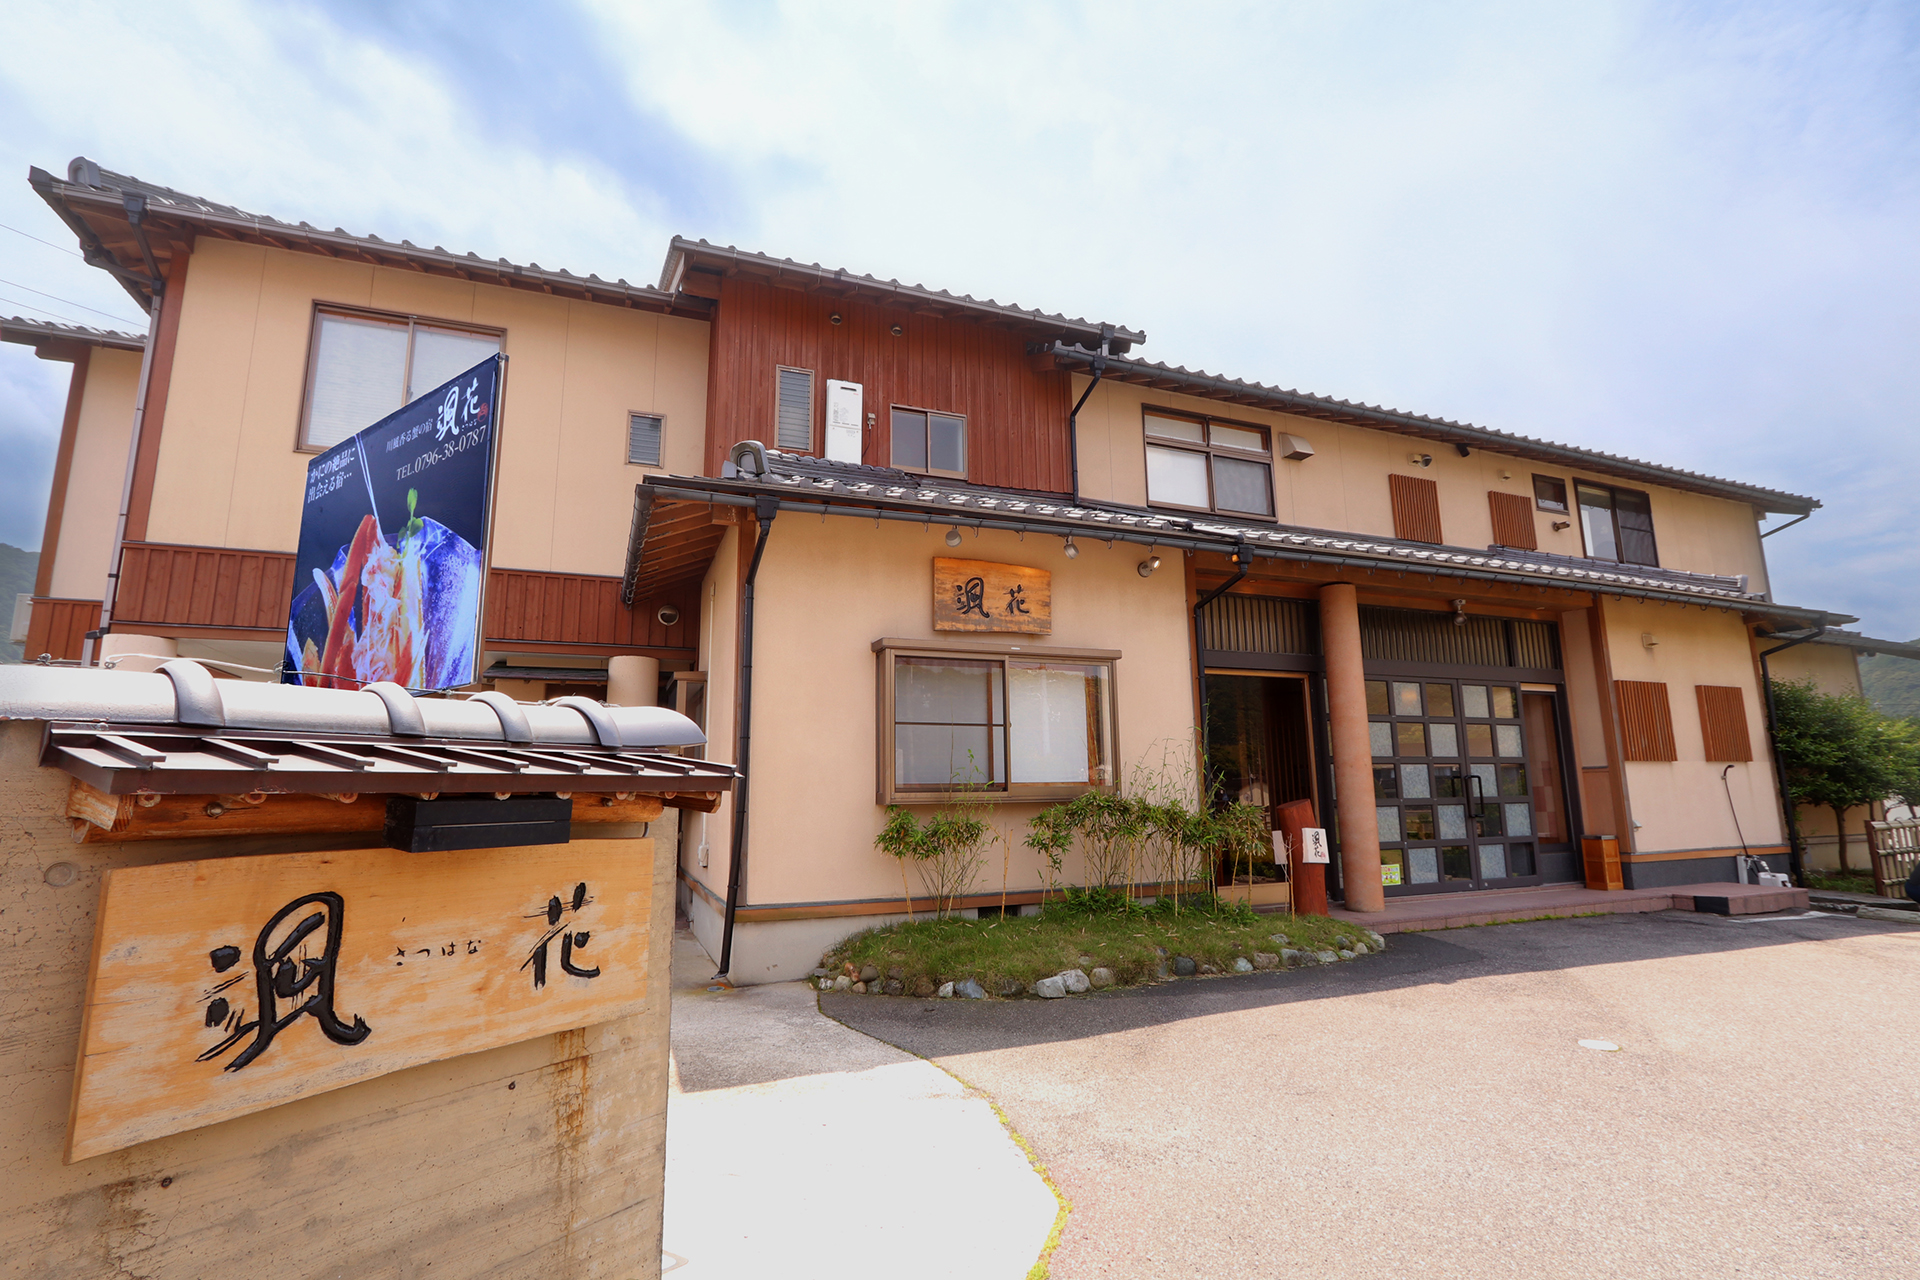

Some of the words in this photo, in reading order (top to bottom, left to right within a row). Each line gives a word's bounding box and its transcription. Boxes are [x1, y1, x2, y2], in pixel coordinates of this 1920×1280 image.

[436, 377, 480, 441] 颯花
[309, 447, 355, 484] かにの絶品に
[396, 425, 487, 480] TEL.0796-38-0787
